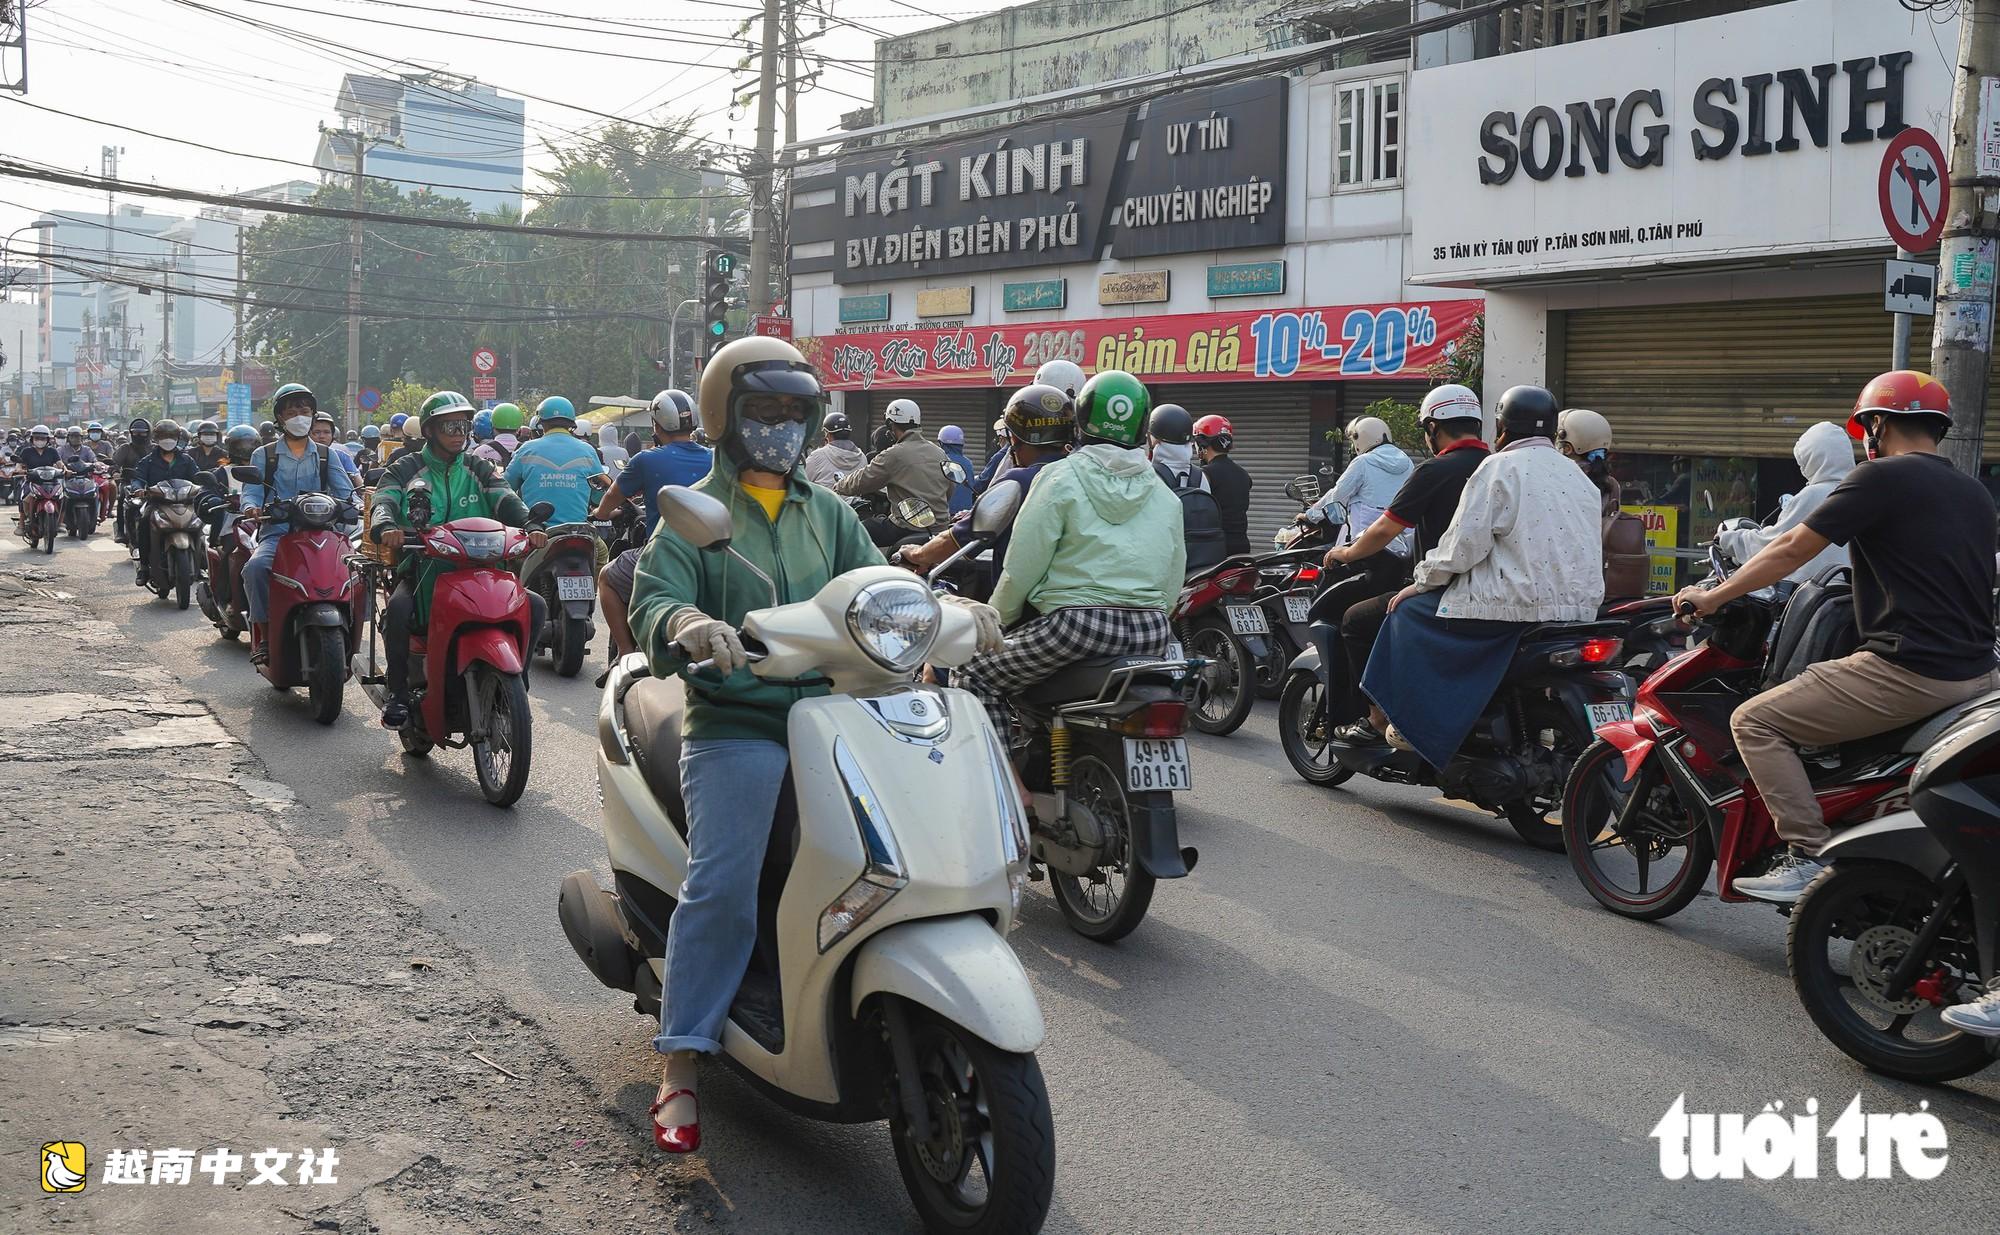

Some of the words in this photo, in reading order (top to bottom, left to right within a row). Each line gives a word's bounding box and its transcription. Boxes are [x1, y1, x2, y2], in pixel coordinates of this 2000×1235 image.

[1166, 121, 1193, 156] UY
[1197, 110, 1229, 151] TÍN
[1477, 87, 1670, 186] SONG
[1690, 50, 1914, 162] SINH
[844, 149, 945, 218] MẮT
[959, 137, 1088, 202] KÍNH
[1123, 184, 1197, 228] CHUYÊN
[1201, 175, 1273, 225] NGHIỆP
[846, 224, 942, 270] BV.ĐIỆN
[948, 215, 1012, 259] BIÊN
[1019, 200, 1079, 253] PHỦ
[1433, 246, 1447, 260] 35
[1450, 242, 1471, 259] TÂN
[1473, 239, 1488, 257] KỲ
[1492, 238, 1513, 256] TÂN
[1516, 235, 1539, 255] QUÝ
[1545, 232, 1578, 251] P.TÂN
[1581, 230, 1606, 247] SƠN
[1609, 225, 1634, 245] NHÌ,
[1637, 222, 1673, 244] Q.TÂN
[1676, 218, 1703, 239] PHÚ
[882, 338, 928, 379] Xuân
[934, 329, 977, 370] Bính
[1023, 328, 1086, 367] 2026
[1094, 326, 1177, 375] Giảm
[1184, 323, 1242, 375] Giá
[1103, 421, 1127, 432] gojek
[1130, 764, 1188, 789] 081.61
[1135, 740, 1183, 764] 49-B1
